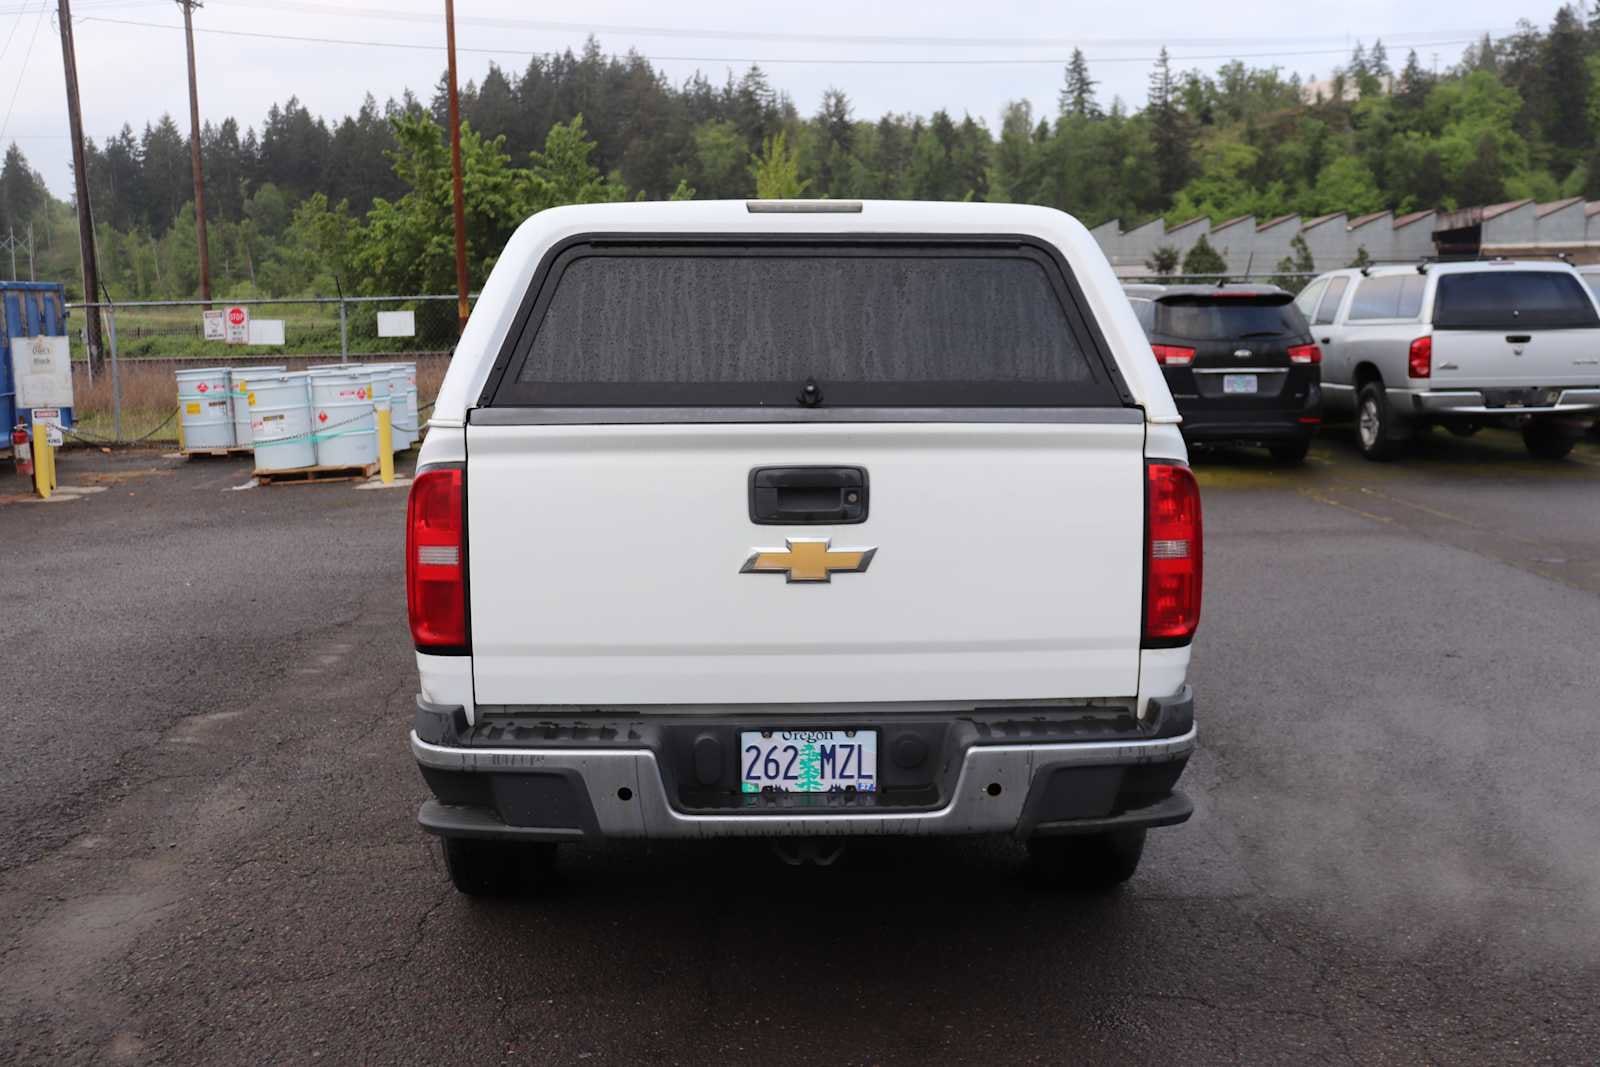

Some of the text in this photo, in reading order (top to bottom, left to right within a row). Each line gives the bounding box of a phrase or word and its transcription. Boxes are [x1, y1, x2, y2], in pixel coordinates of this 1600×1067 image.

[229, 312, 245, 321] STOP
[782, 731, 833, 743] Oregon
[745, 744, 873, 780] 262 MZL
